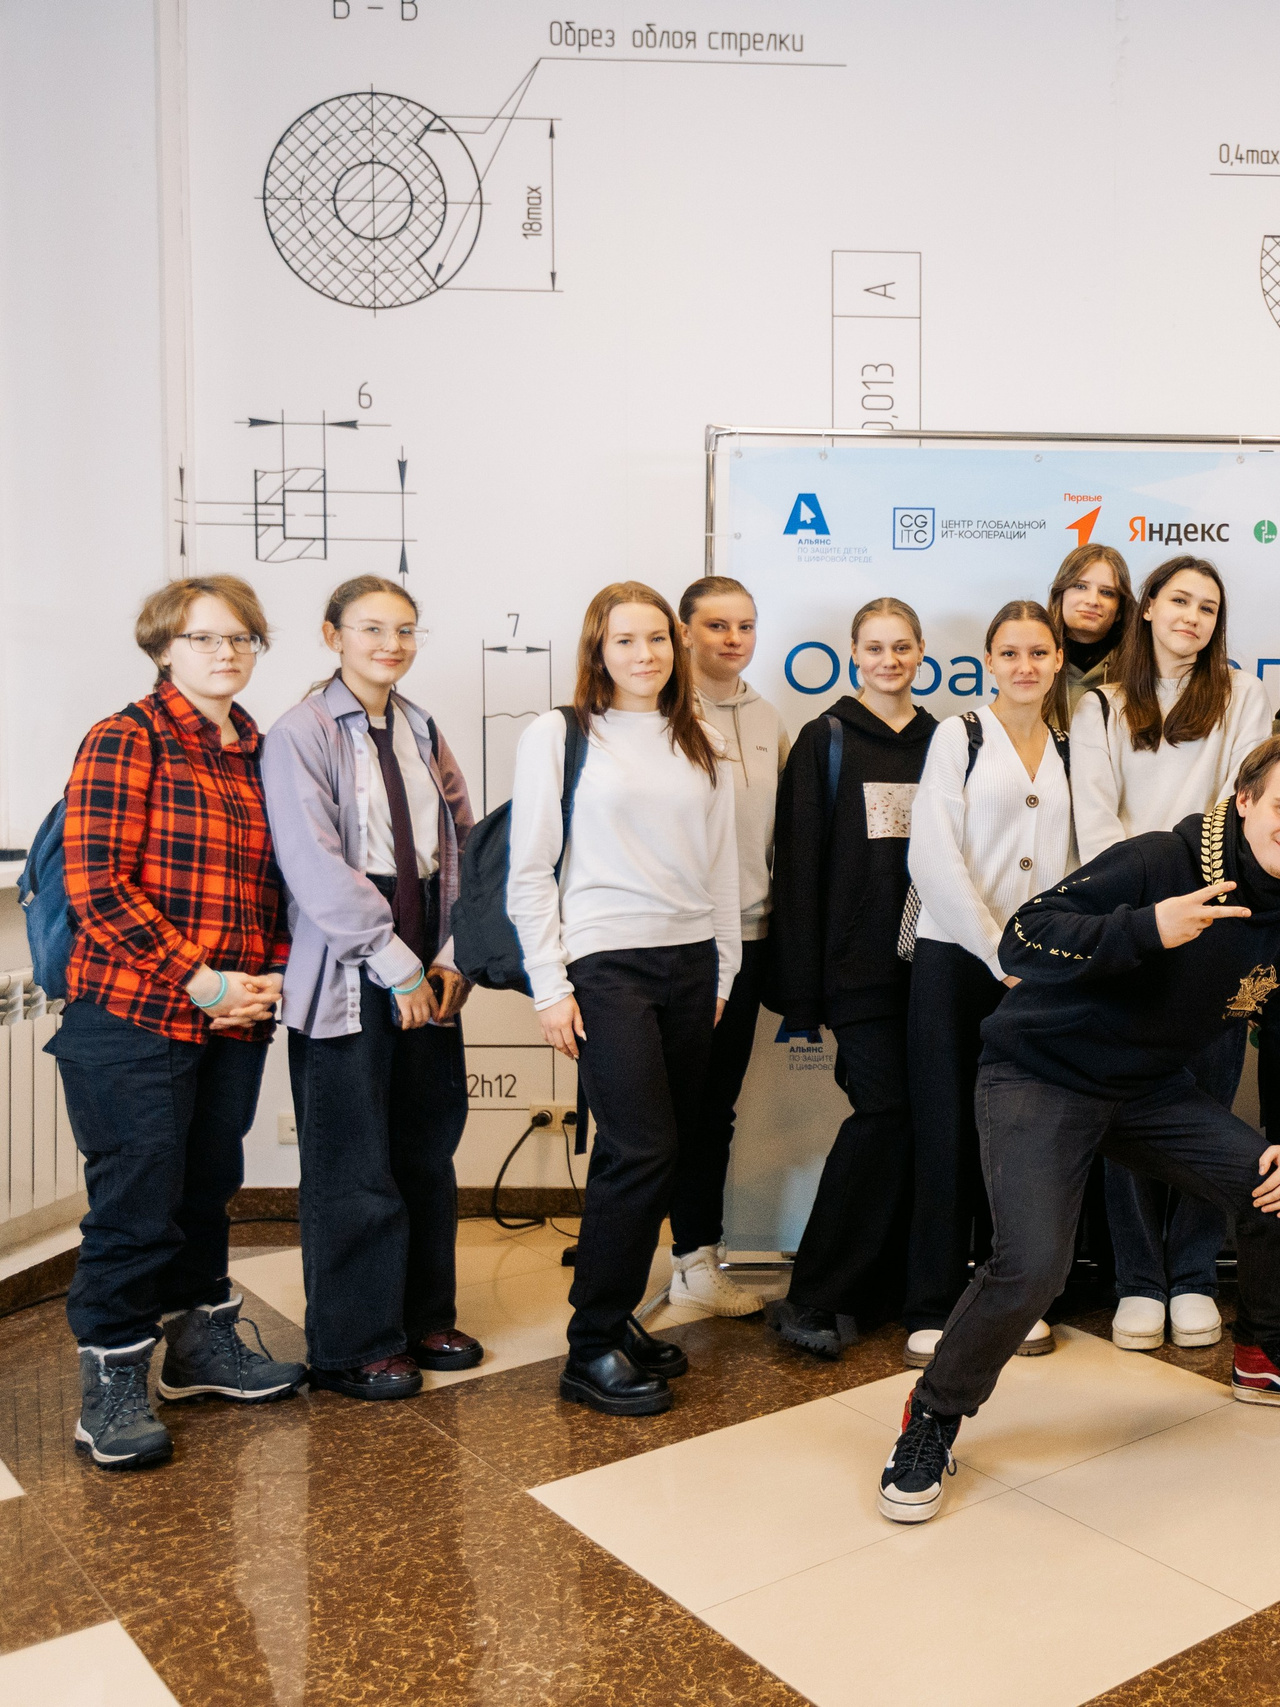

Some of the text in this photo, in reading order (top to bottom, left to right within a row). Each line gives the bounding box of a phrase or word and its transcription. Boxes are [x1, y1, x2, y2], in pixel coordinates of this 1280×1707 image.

[549, 20, 804, 57] Обрез облоя стрелки
[1218, 143, 1280, 167] 0,4max
[521, 185, 543, 240] 18max
[358, 381, 373, 410] 6
[1063, 492, 1103, 504] Первые
[900, 514, 928, 528] CG
[941, 519, 1047, 530] ЦЕНТР ГЛОБАЛЬНОЙ
[900, 529, 928, 544] ITC
[941, 530, 1027, 541] ИТ-КООПЕРАЦИИ
[1128, 516, 1230, 546] Яндекс
[797, 538, 832, 546] АЛЬЯНС
[507, 613, 520, 638] 7
